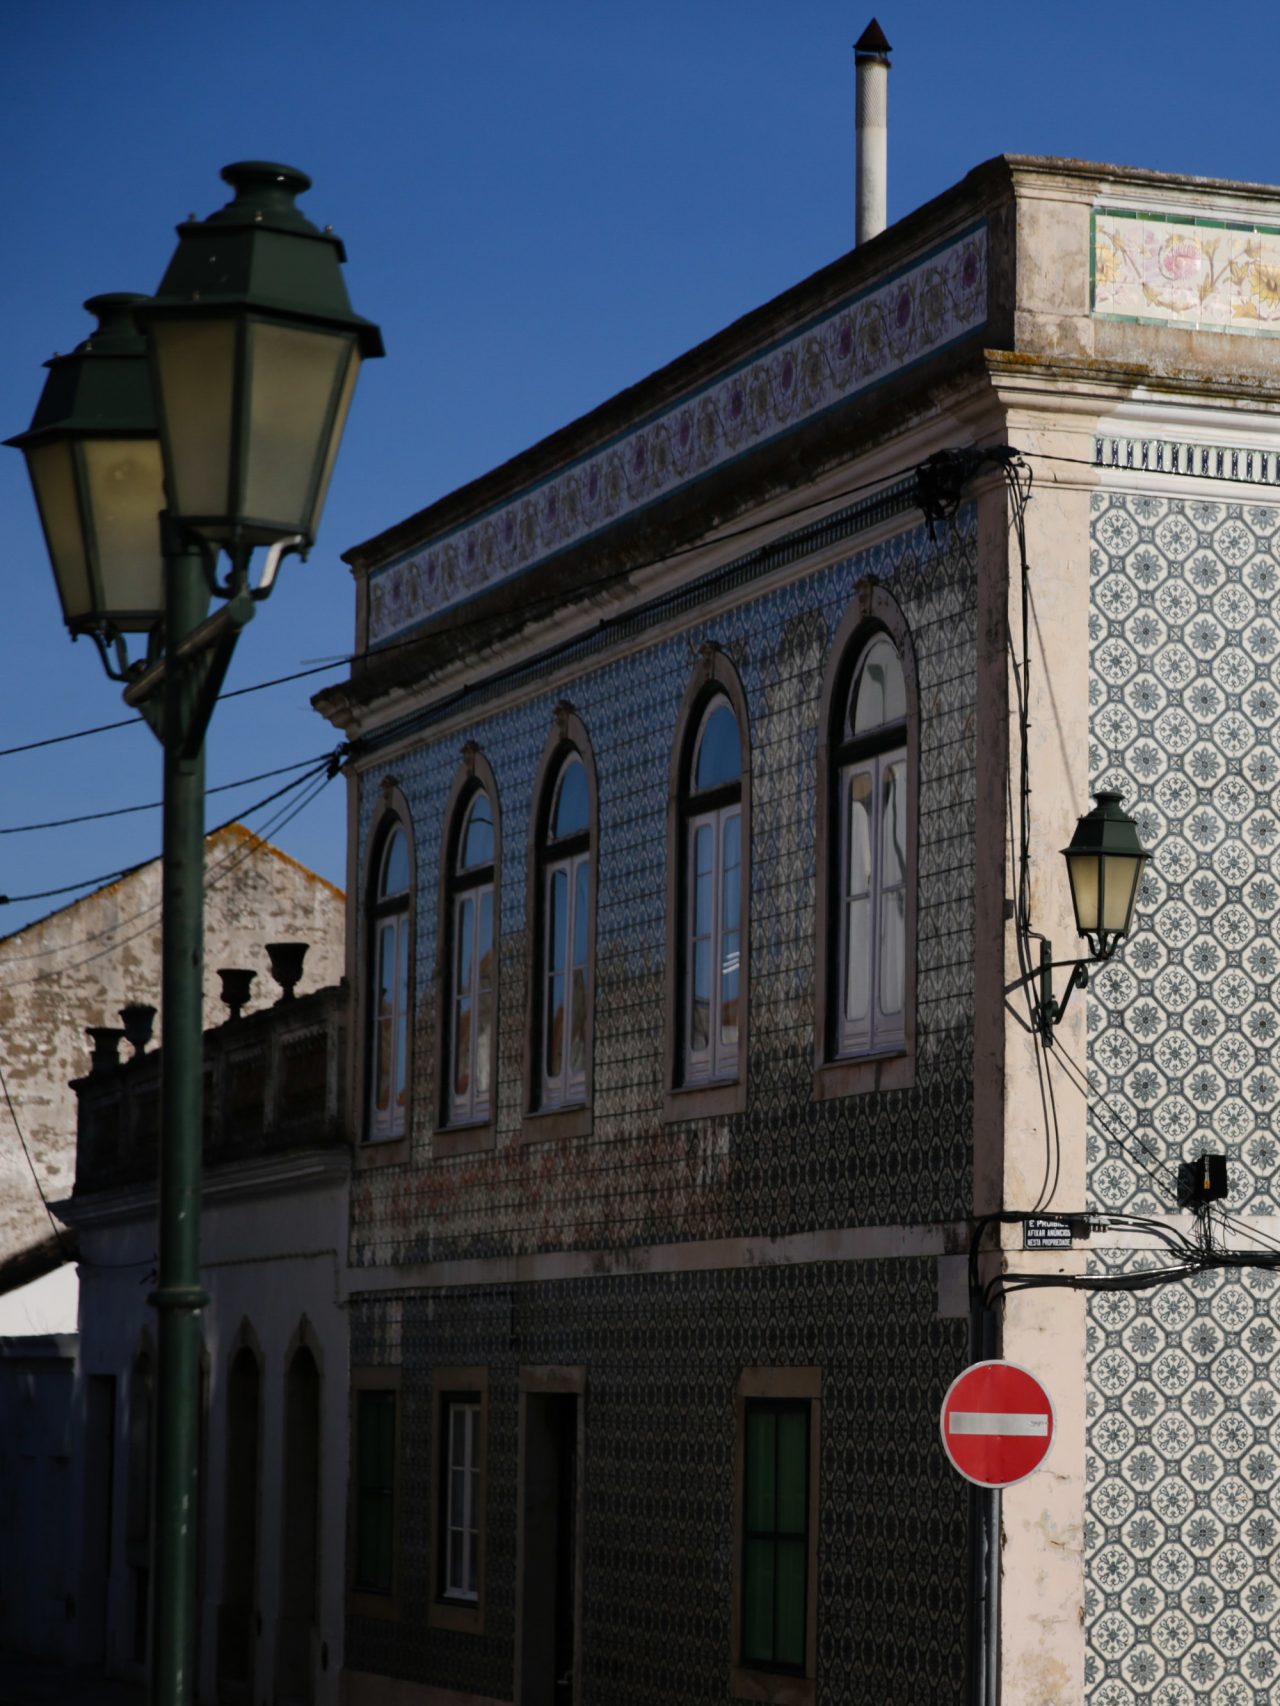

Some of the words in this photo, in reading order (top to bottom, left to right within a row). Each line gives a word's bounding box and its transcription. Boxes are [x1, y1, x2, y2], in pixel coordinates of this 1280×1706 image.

[1027, 1229, 1046, 1237] AFIXAR
[1027, 1238, 1041, 1246] NESTA
[1042, 1238, 1071, 1246] PROPRIEDADE
